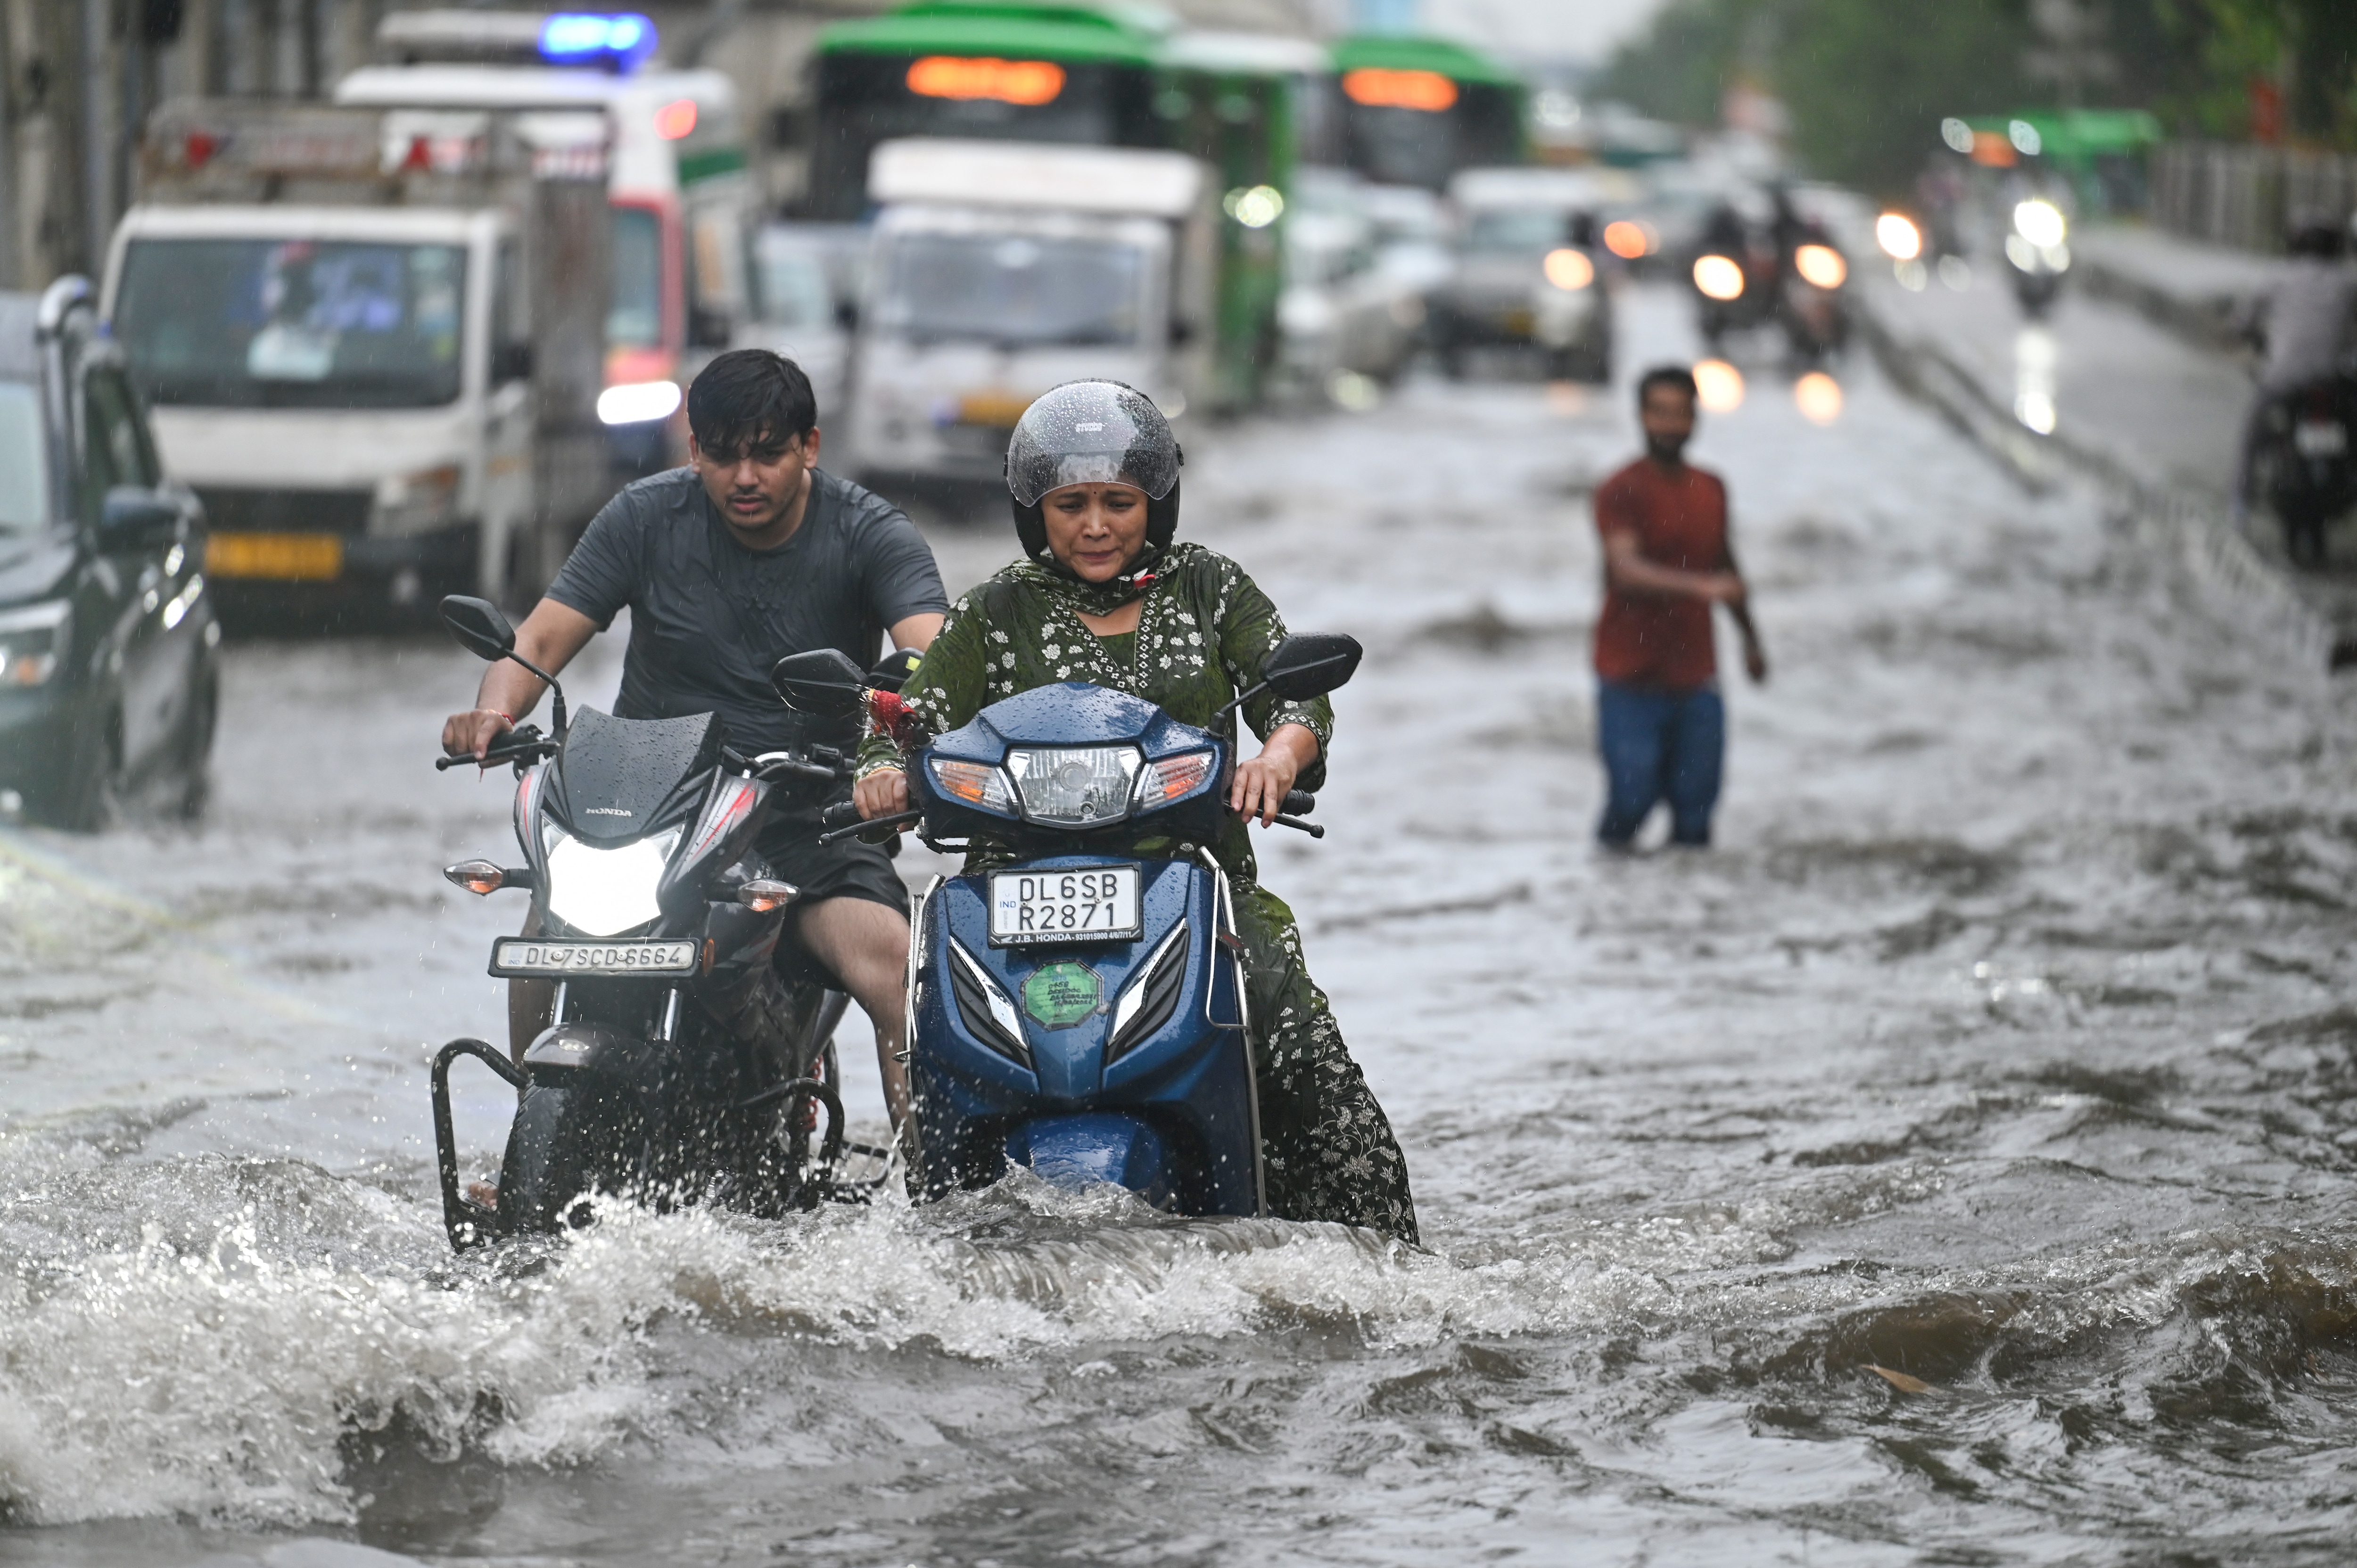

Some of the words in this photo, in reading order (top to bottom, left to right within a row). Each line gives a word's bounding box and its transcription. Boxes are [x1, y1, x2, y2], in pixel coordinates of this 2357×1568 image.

[585, 807, 632, 817] HONDA
[1019, 874, 1117, 902] DL6SB
[1019, 903, 1114, 930] R2871
[1015, 935, 1033, 943] J.B.
